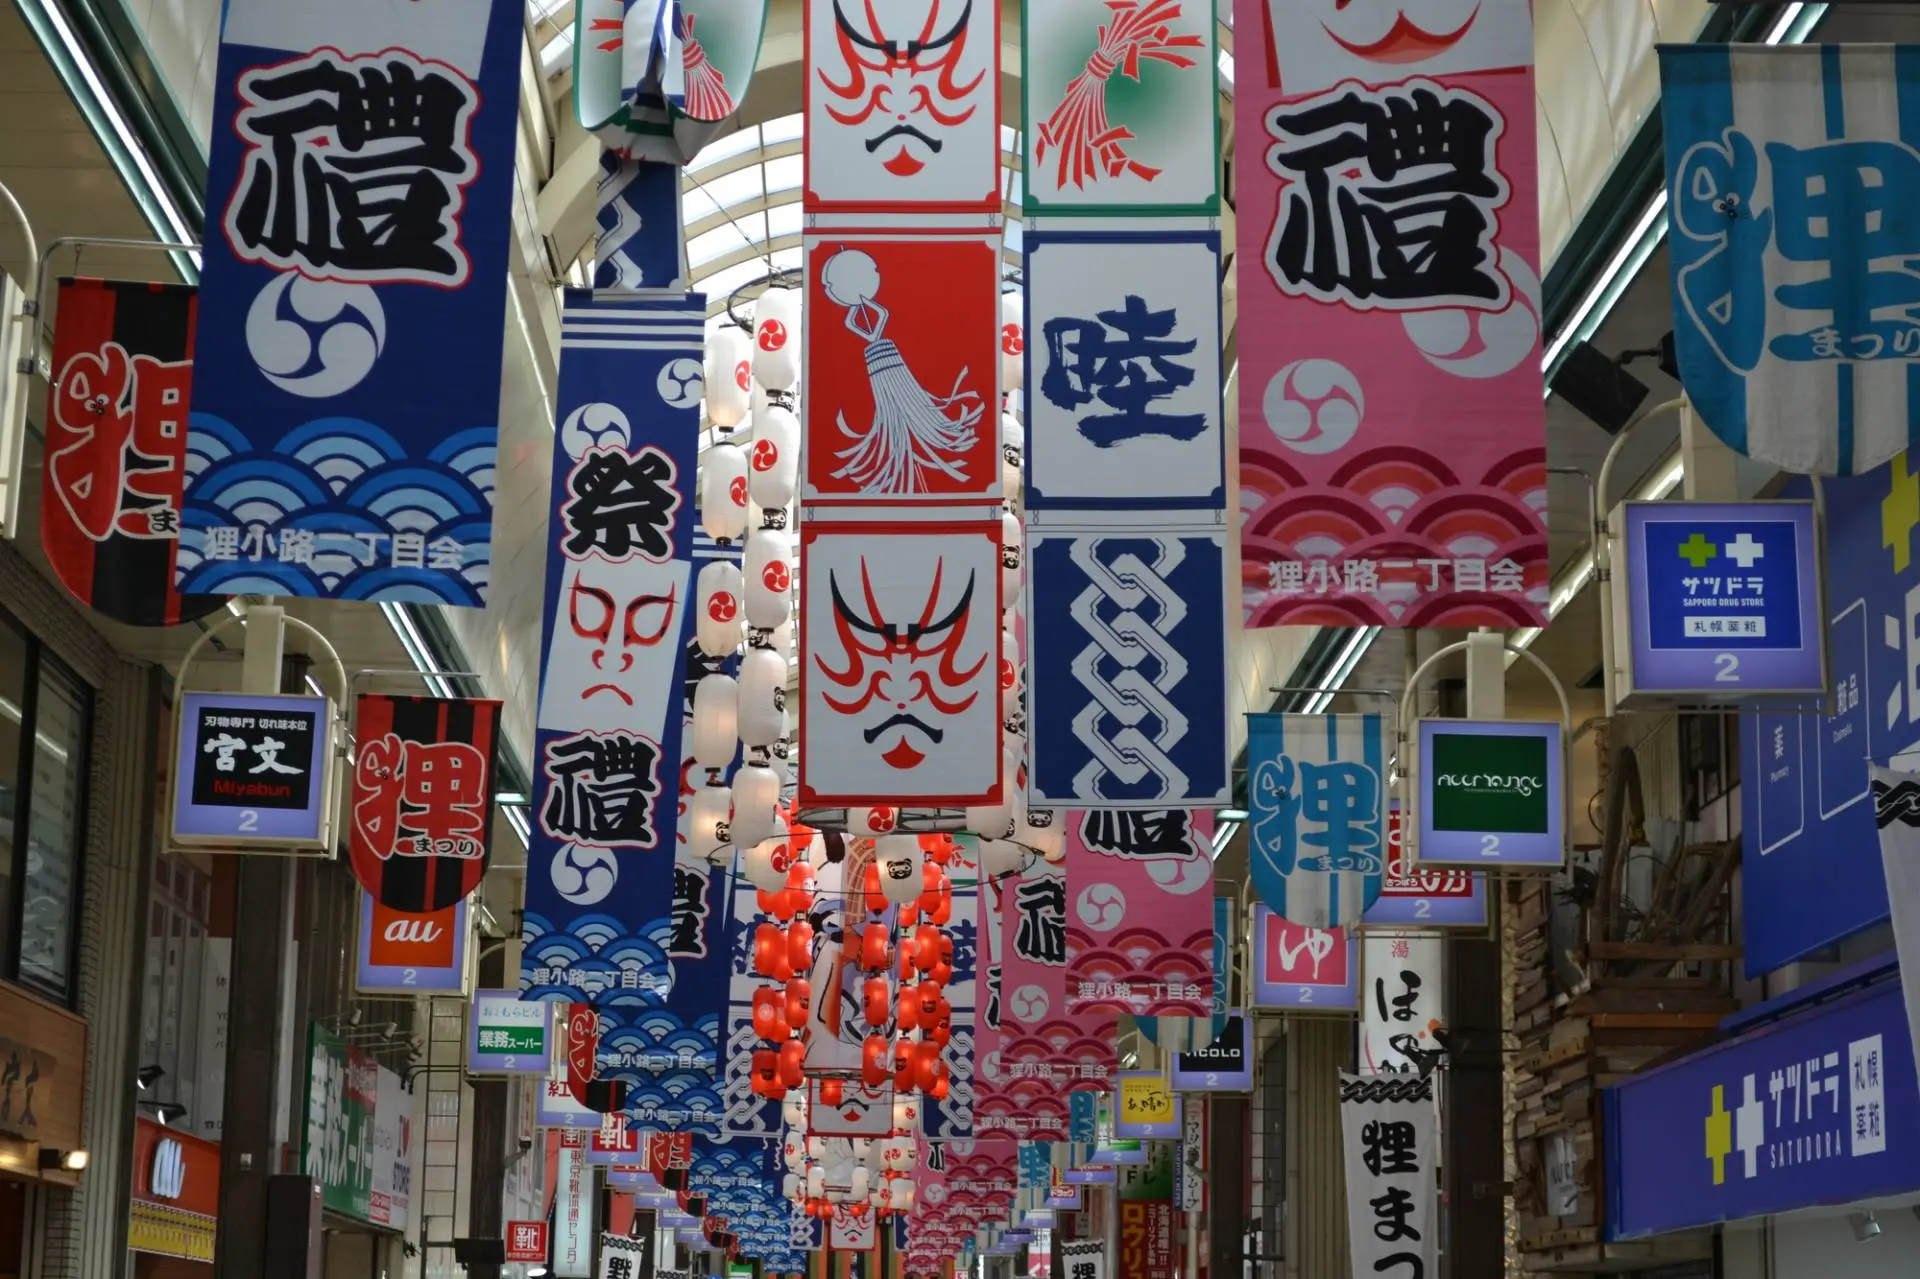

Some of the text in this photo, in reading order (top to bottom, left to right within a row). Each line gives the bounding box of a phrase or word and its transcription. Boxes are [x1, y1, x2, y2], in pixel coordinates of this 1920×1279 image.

[1041, 295, 1209, 448] 睦
[565, 450, 677, 558] 祭
[1267, 557, 1525, 595] 狸小路二丁目会
[1682, 577, 1764, 596] サツドラ
[1683, 598, 1764, 608] SAPPORO DRUG STORE
[1714, 653, 1741, 681] 2
[204, 715, 307, 731] 刃物専門 切れ味本位
[203, 733, 304, 774] 宮文
[213, 779, 291, 798] Miyabun
[238, 810, 258, 832] 2
[414, 838, 475, 855] まつり
[1480, 835, 1501, 856] 2
[1316, 856, 1374, 872] まつり
[1414, 900, 1432, 918] 2
[384, 919, 443, 943] au
[403, 969, 417, 984] 2
[1078, 982, 1202, 1001] 狸小路二丁目会
[1299, 987, 1313, 1003] 2
[479, 1031, 543, 1049] 業務スーパー
[504, 1056, 516, 1068] 2
[1206, 1074, 1218, 1086] 2
[1769, 1052, 1840, 1128] サツドラ
[565, 1114, 575, 1124] 2
[1143, 1124, 1153, 1134] 2
[610, 1154, 619, 1162] 2
[1113, 1152, 1122, 1161] 2
[1770, 1130, 1842, 1169] SATUDORA
[630, 1174, 637, 1182] 2
[1086, 1172, 1094, 1181] 2
[516, 1227, 538, 1249] 靴
